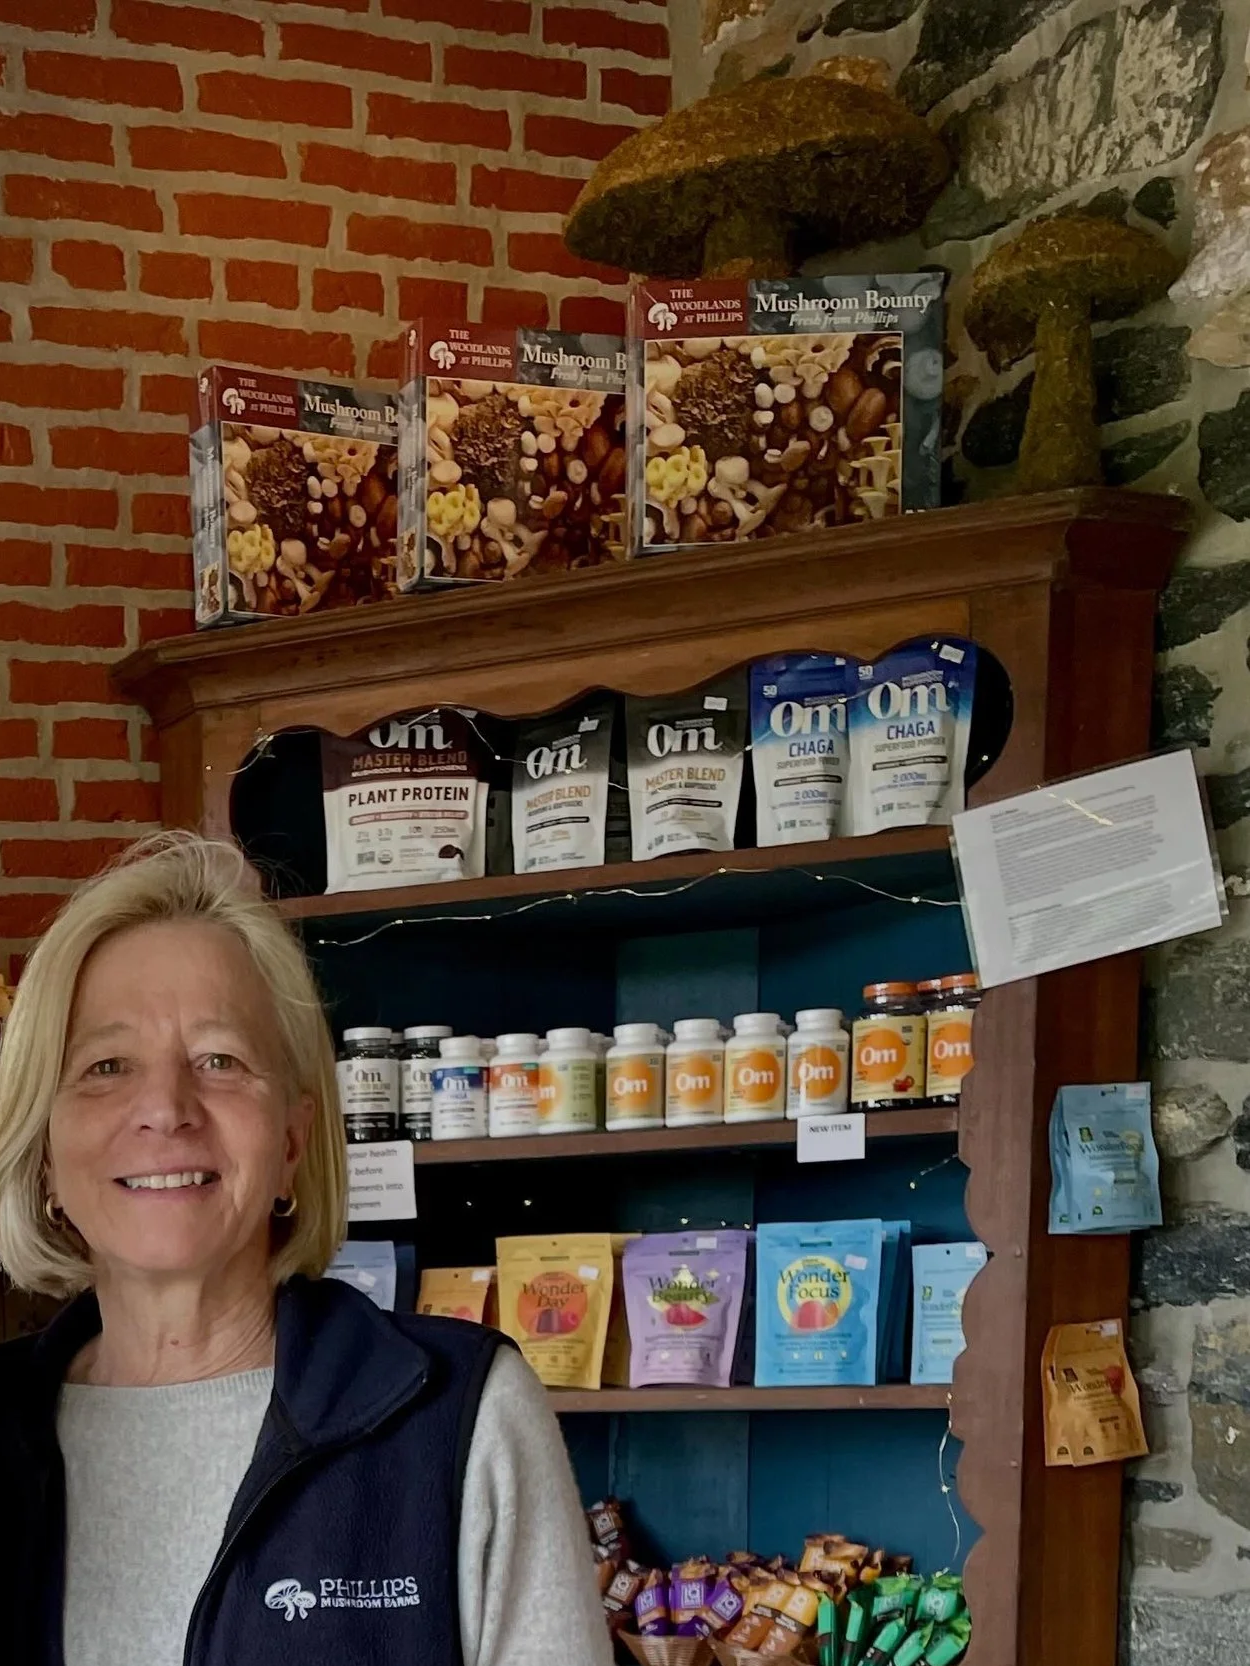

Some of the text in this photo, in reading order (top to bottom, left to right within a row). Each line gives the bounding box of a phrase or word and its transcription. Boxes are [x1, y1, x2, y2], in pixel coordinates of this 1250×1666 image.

[670, 288, 694, 299] THE
[670, 300, 741, 311] WOODLANDS
[755, 290, 933, 313] Mushroom Bounty
[682, 312, 743, 323] AT PHILLIPS
[854, 311, 898, 327] Phillips
[449, 329, 470, 340] THE
[449, 342, 511, 355] WOODLANDS
[471, 356, 512, 368] PHILLIPS
[522, 343, 610, 370] Mushroom
[238, 377, 257, 388] THE
[238, 388, 294, 404] WOODLANDS
[259, 403, 296, 417] PHILLIPS
[304, 393, 381, 422] Mushroom
[858, 666, 873, 676] 50
[762, 685, 778, 696] 50
[868, 682, 950, 719] Om
[770, 701, 846, 737] Om
[369, 720, 453, 749] Om
[887, 720, 935, 740] CHAGA
[647, 724, 724, 757] Om
[789, 739, 835, 758] CHAGA
[352, 751, 467, 770] MASTER BLEND
[527, 744, 588, 779] Om
[645, 768, 684, 791] MASTER
[687, 767, 726, 782] BLEND
[349, 786, 469, 807] PLANT PROTEIN
[555, 785, 591, 799] BLEND
[860, 1047, 898, 1066] Om
[934, 1040, 971, 1060] Om
[355, 1069, 382, 1082] Om
[739, 1067, 774, 1086] Om
[798, 1060, 834, 1082] Om
[442, 1077, 470, 1091] Om
[501, 1073, 529, 1088] Om
[614, 1077, 648, 1095] Om
[676, 1072, 710, 1091] Om
[540, 1086, 556, 1099] m
[809, 1124, 852, 1133] NEW ITEM
[369, 1149, 398, 1157] health
[354, 1167, 383, 1176] before
[649, 1276, 717, 1290] Wonder
[779, 1268, 851, 1284] Wonder
[522, 1282, 588, 1296] Wonder
[789, 1285, 841, 1300] Focus
[537, 1296, 570, 1309] Day
[320, 1576, 418, 1598] PHILLIPS
[321, 1594, 421, 1608] MUSHROOM FARMS
